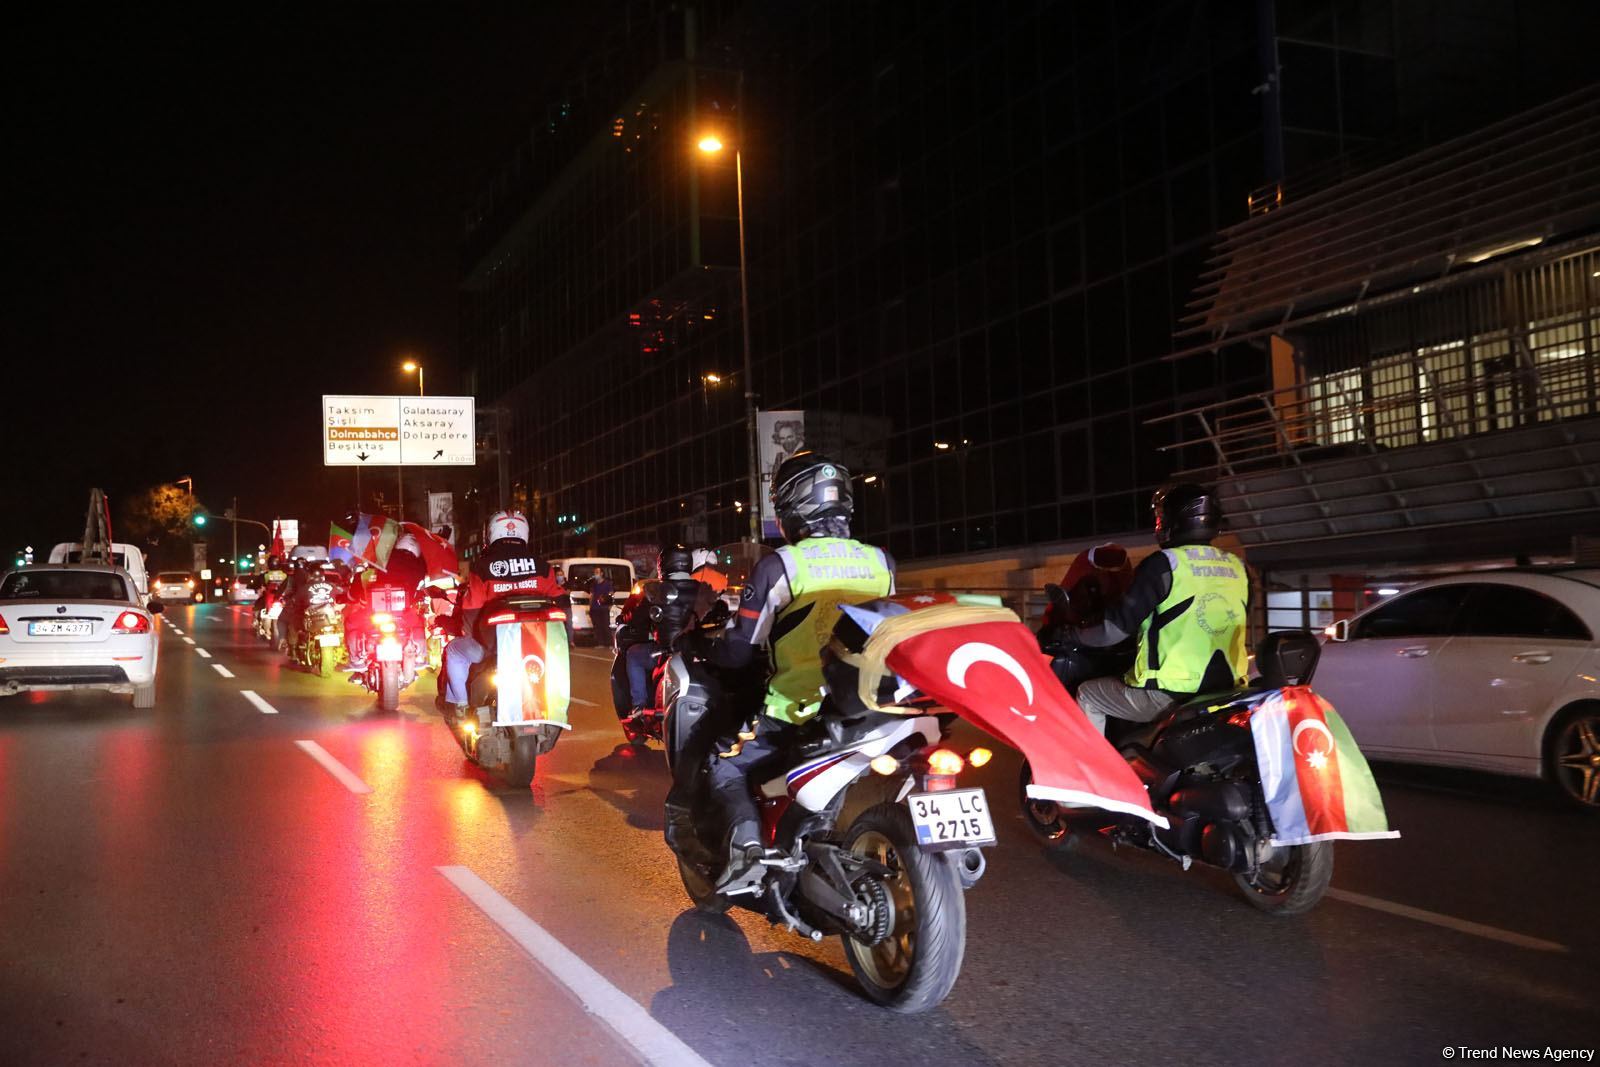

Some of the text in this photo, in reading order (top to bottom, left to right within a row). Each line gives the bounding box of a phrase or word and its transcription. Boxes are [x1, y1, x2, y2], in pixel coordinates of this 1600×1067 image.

[328, 406, 375, 415] Taksim
[403, 406, 465, 416] Galatasaray
[328, 417, 357, 426] Şişli
[403, 419, 454, 428] Aksaray
[330, 429, 397, 440] Dolmabahçe
[403, 431, 468, 441] Dolapdere
[493, 583, 513, 592] SEARCH
[518, 579, 538, 589] RESCUE
[36, 624, 47, 633] 34
[65, 624, 90, 633] 4377
[916, 795, 982, 818] 34 LC
[936, 818, 981, 840] 2715
